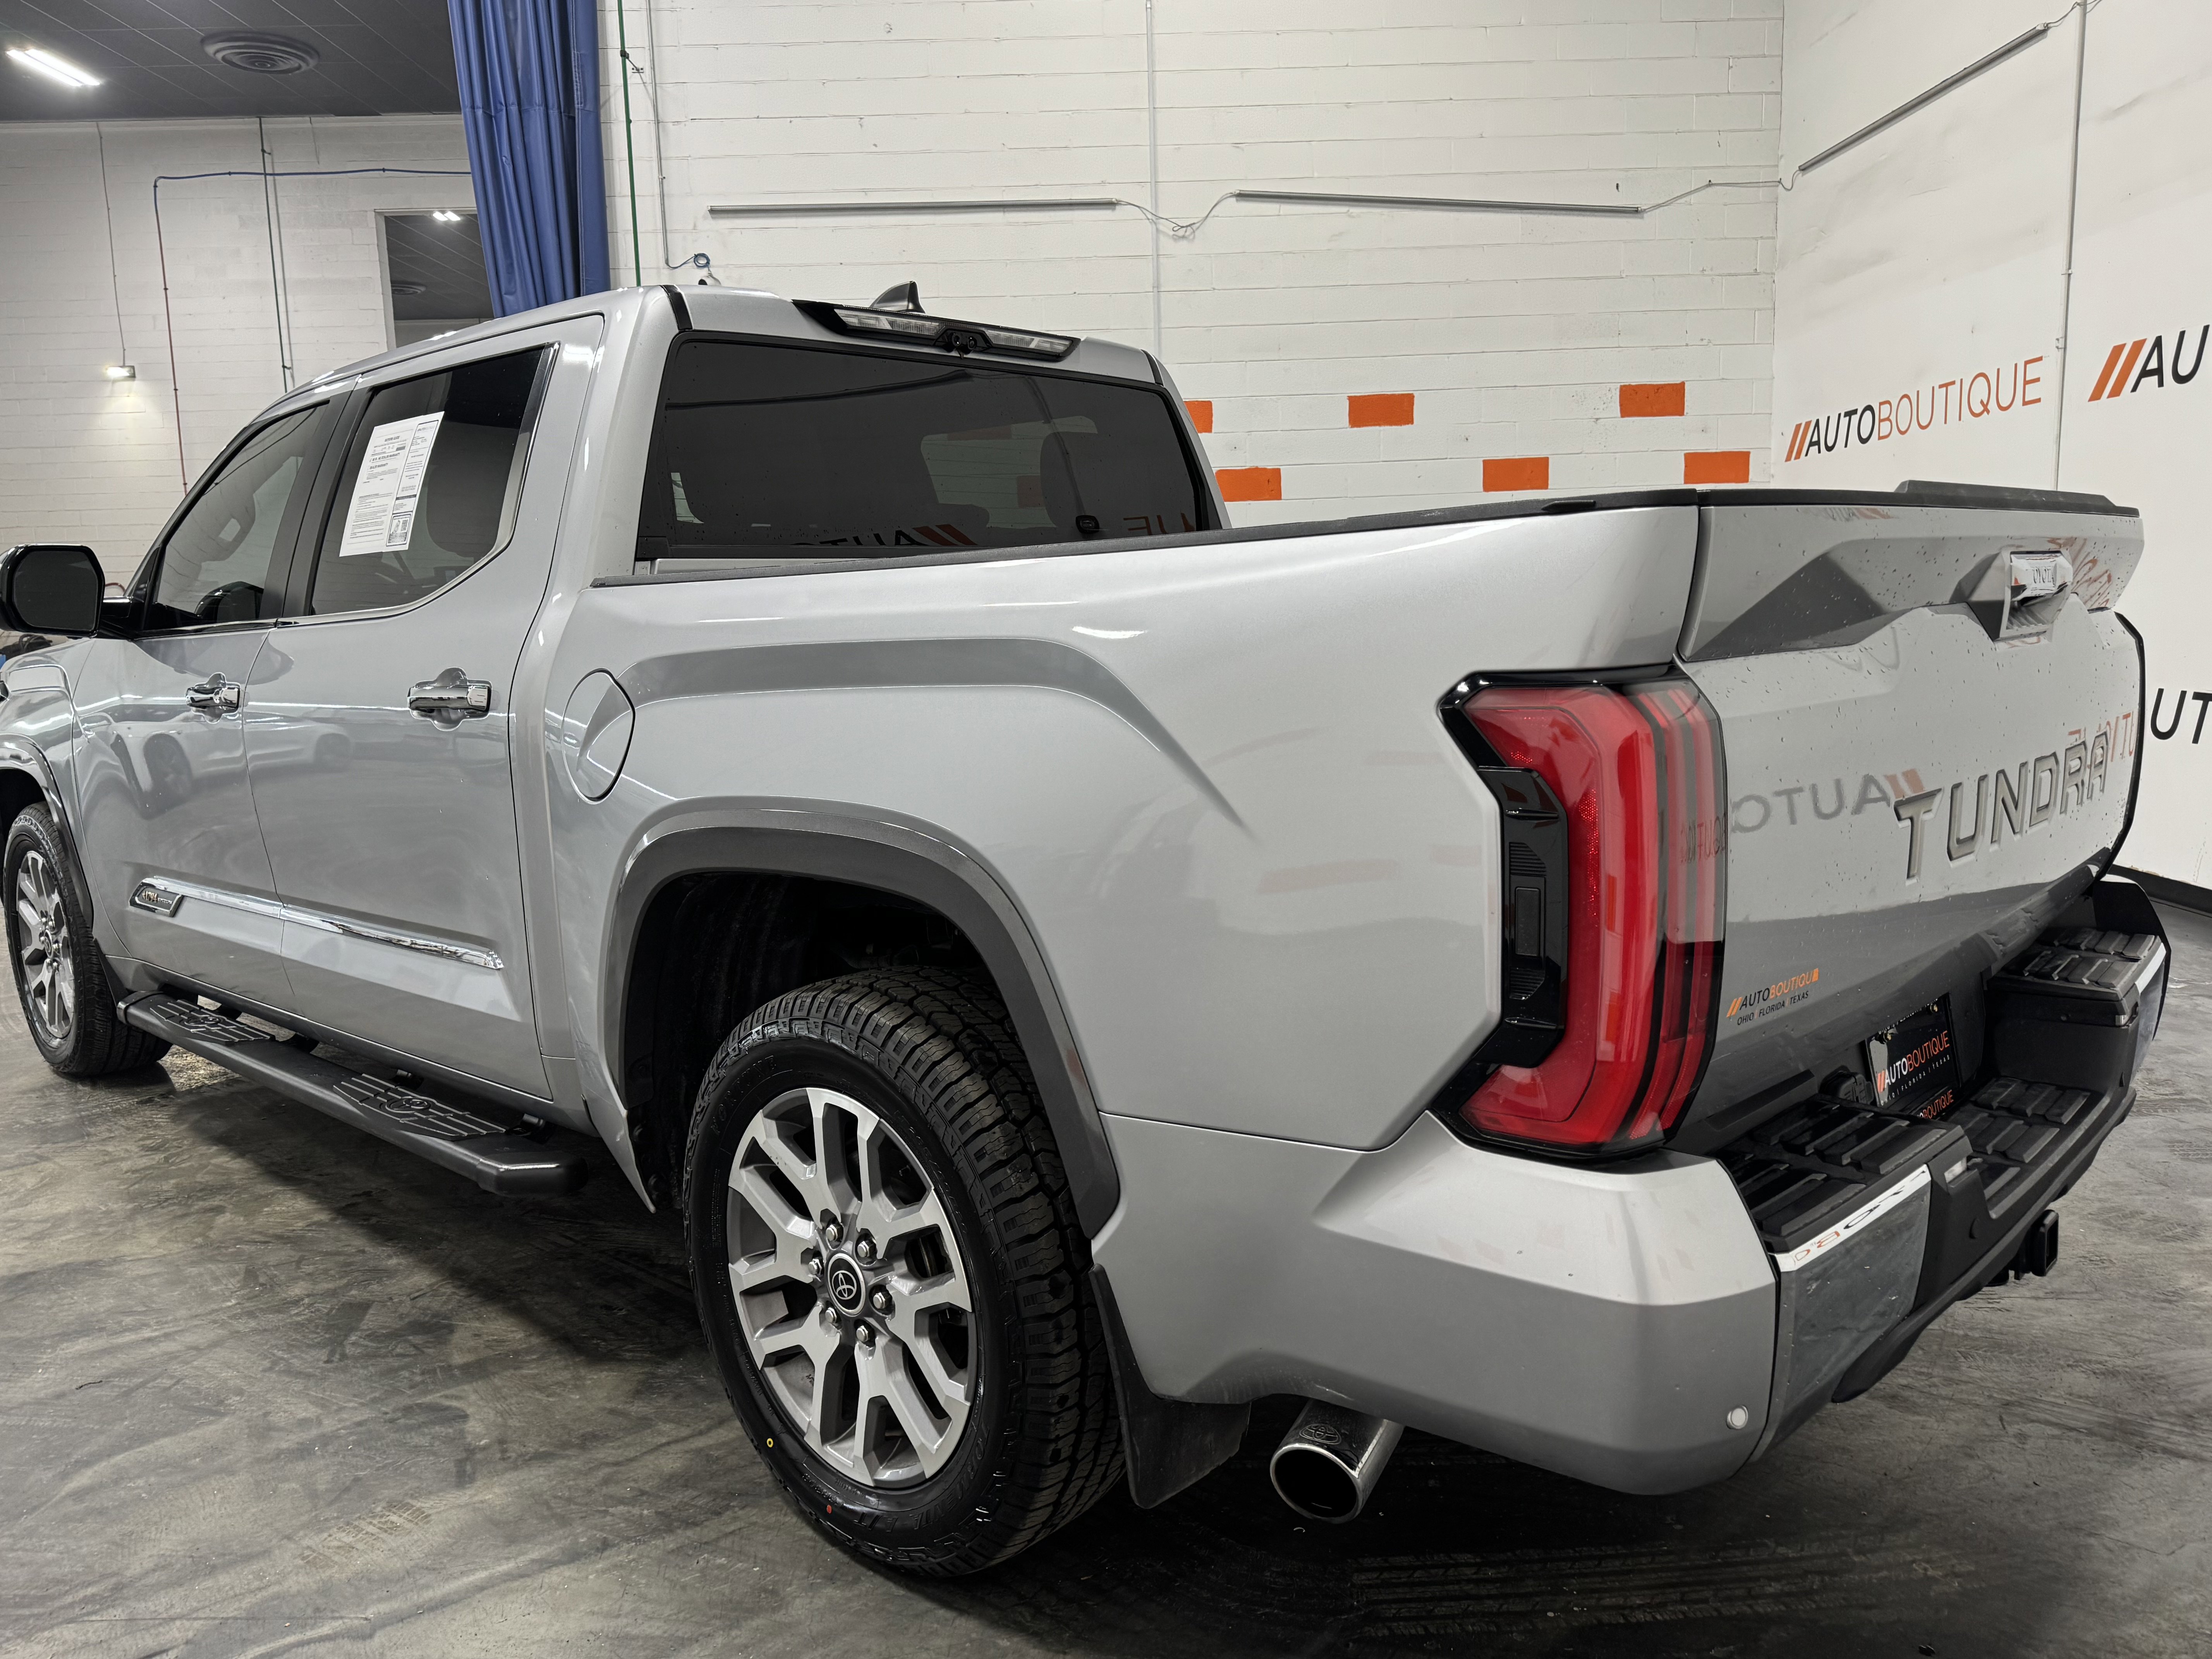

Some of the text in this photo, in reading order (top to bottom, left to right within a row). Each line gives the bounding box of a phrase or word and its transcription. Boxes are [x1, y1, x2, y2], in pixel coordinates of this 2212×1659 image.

[1805, 356, 2043, 457] AUTOBOUTIQUE
[1893, 732, 2109, 886] TUNDRA
[1737, 991, 1809, 1026] OHIO FLORIDA TEXAS
[1884, 1030, 1951, 1089] AUTOBOUTIQUE
[1901, 1071, 1926, 1091] FLORIDA
[1932, 1054, 1950, 1070] TEXAS
